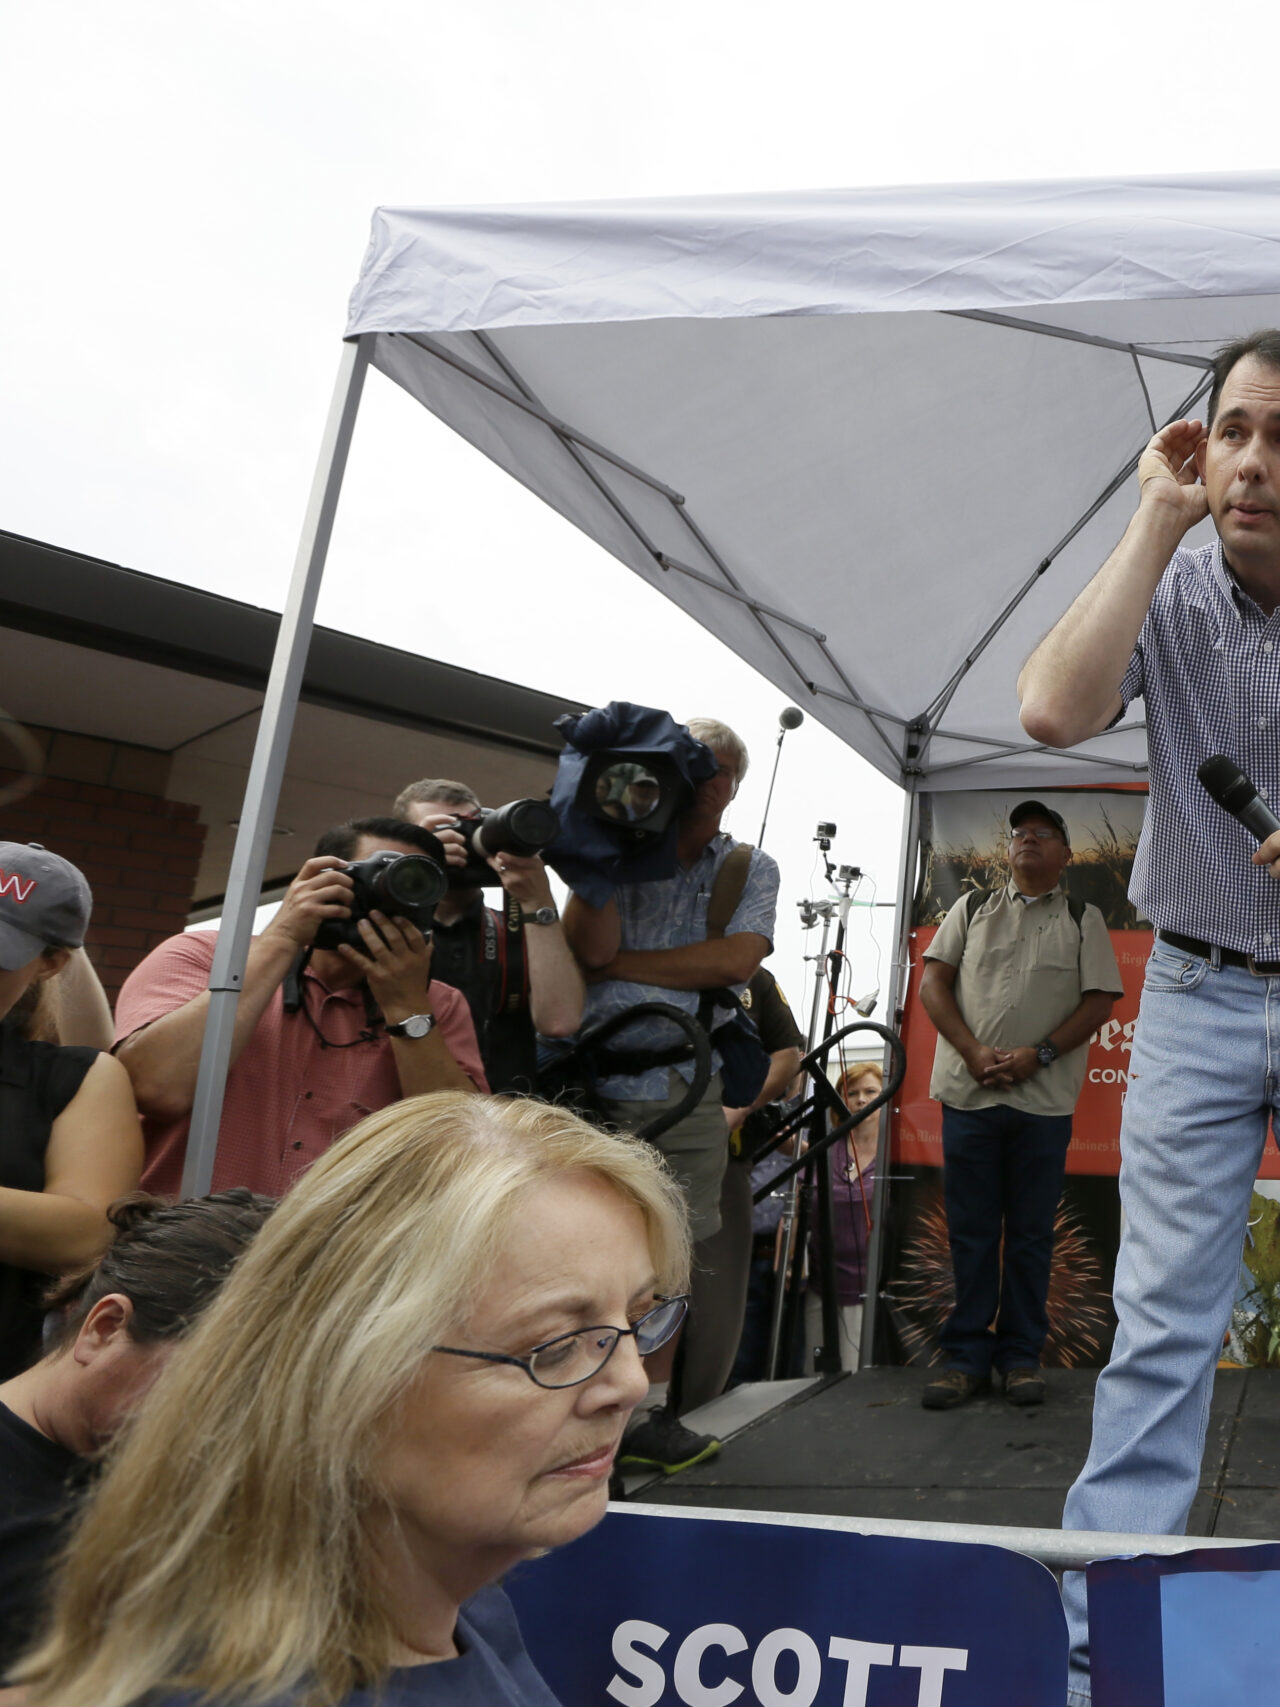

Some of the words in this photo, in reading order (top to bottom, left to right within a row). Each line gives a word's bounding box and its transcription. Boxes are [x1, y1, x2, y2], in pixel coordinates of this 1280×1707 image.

[508, 897, 520, 932] Cano
[485, 938, 496, 960] EOS
[1089, 1018, 1138, 1052] es
[1088, 1068, 1128, 1084] CON
[605, 1618, 969, 1707] SCOTT
